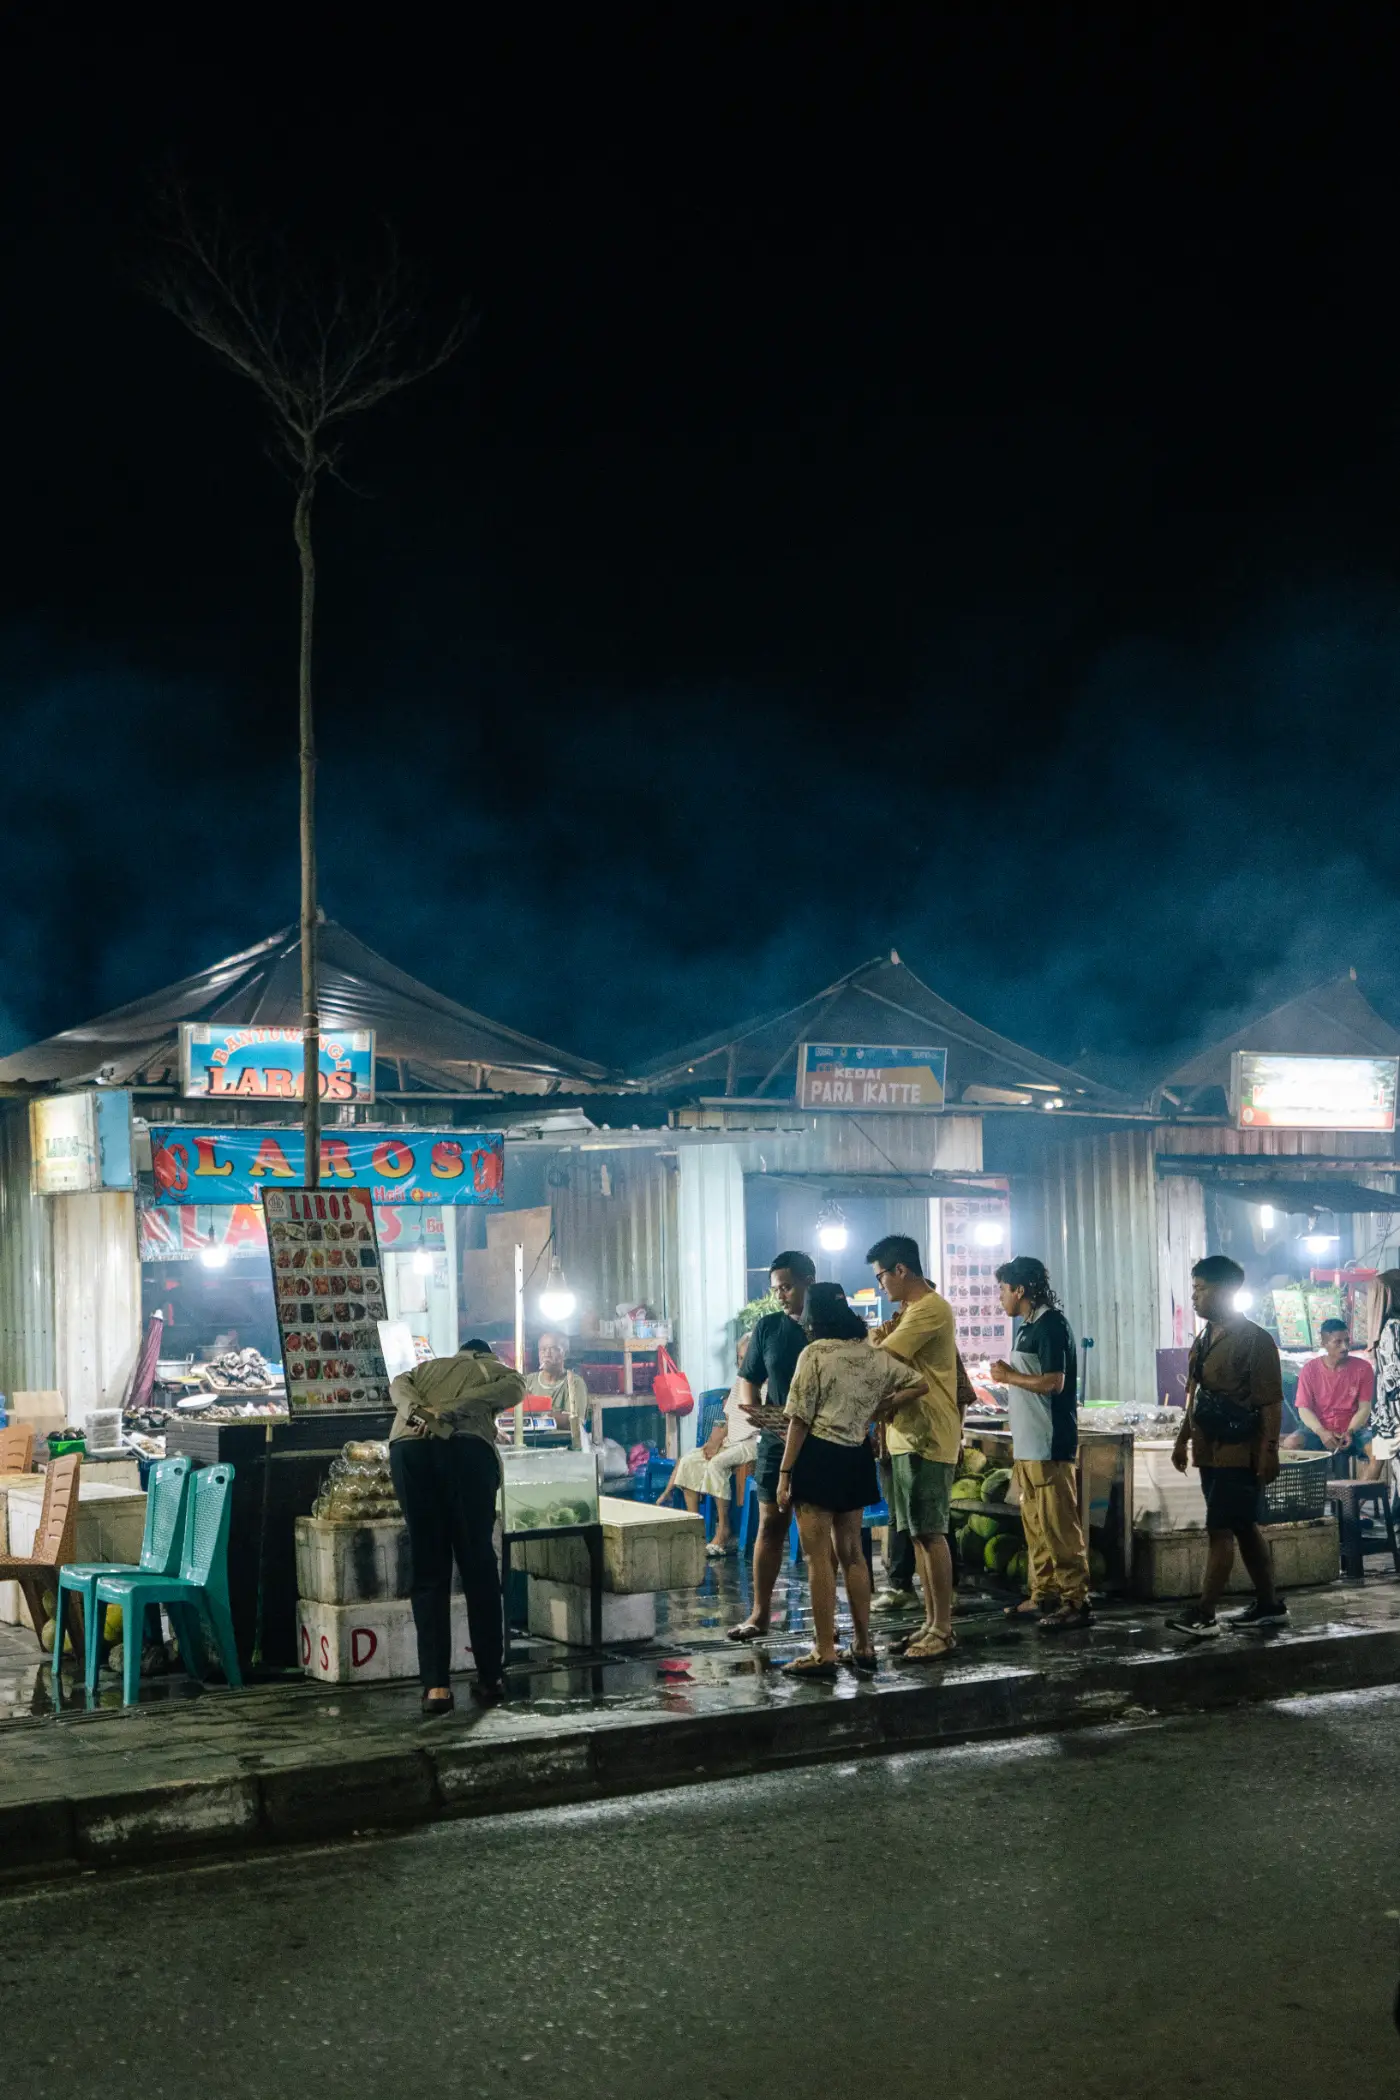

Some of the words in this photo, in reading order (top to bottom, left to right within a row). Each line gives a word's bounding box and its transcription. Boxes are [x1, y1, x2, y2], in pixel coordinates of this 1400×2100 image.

[212, 1027, 351, 1071] BANYUWNGI
[834, 1067, 882, 1080] KEDAI
[811, 1080, 854, 1103] PARA
[863, 1082, 922, 1105] IKATTE
[192, 1136, 465, 1180] LAROS
[288, 1193, 353, 1221] LAROS
